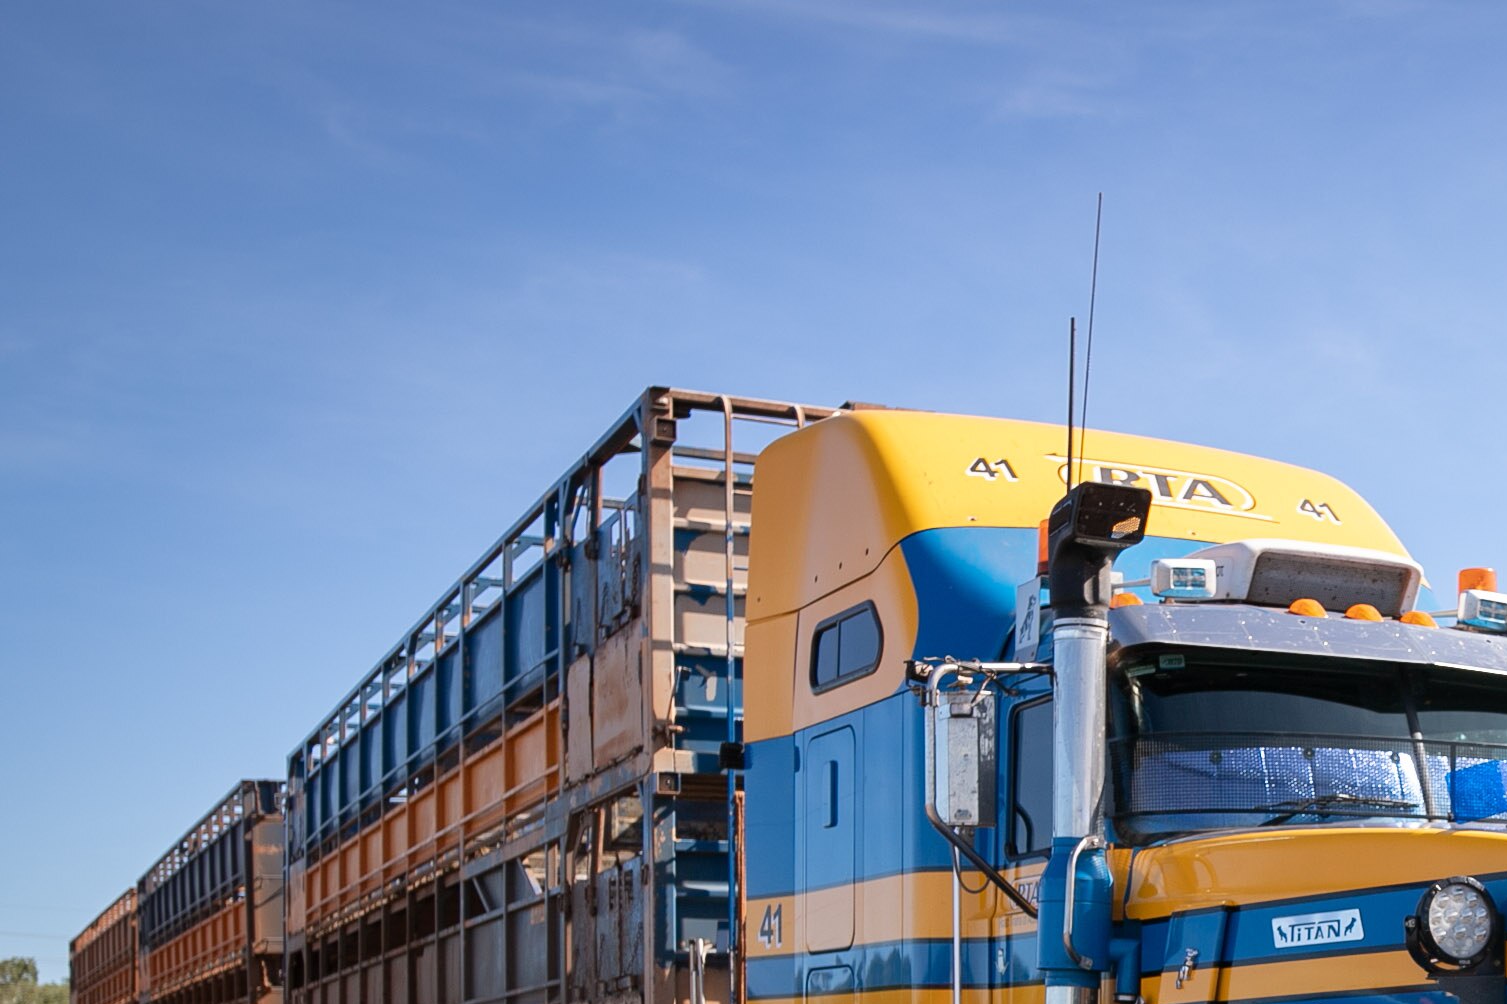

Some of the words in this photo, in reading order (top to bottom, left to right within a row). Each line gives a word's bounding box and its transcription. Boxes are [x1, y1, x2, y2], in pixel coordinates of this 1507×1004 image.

[967, 457, 1019, 482] 41
[1096, 466, 1233, 508] RTA
[1297, 498, 1342, 525] 41
[758, 904, 782, 947] 41
